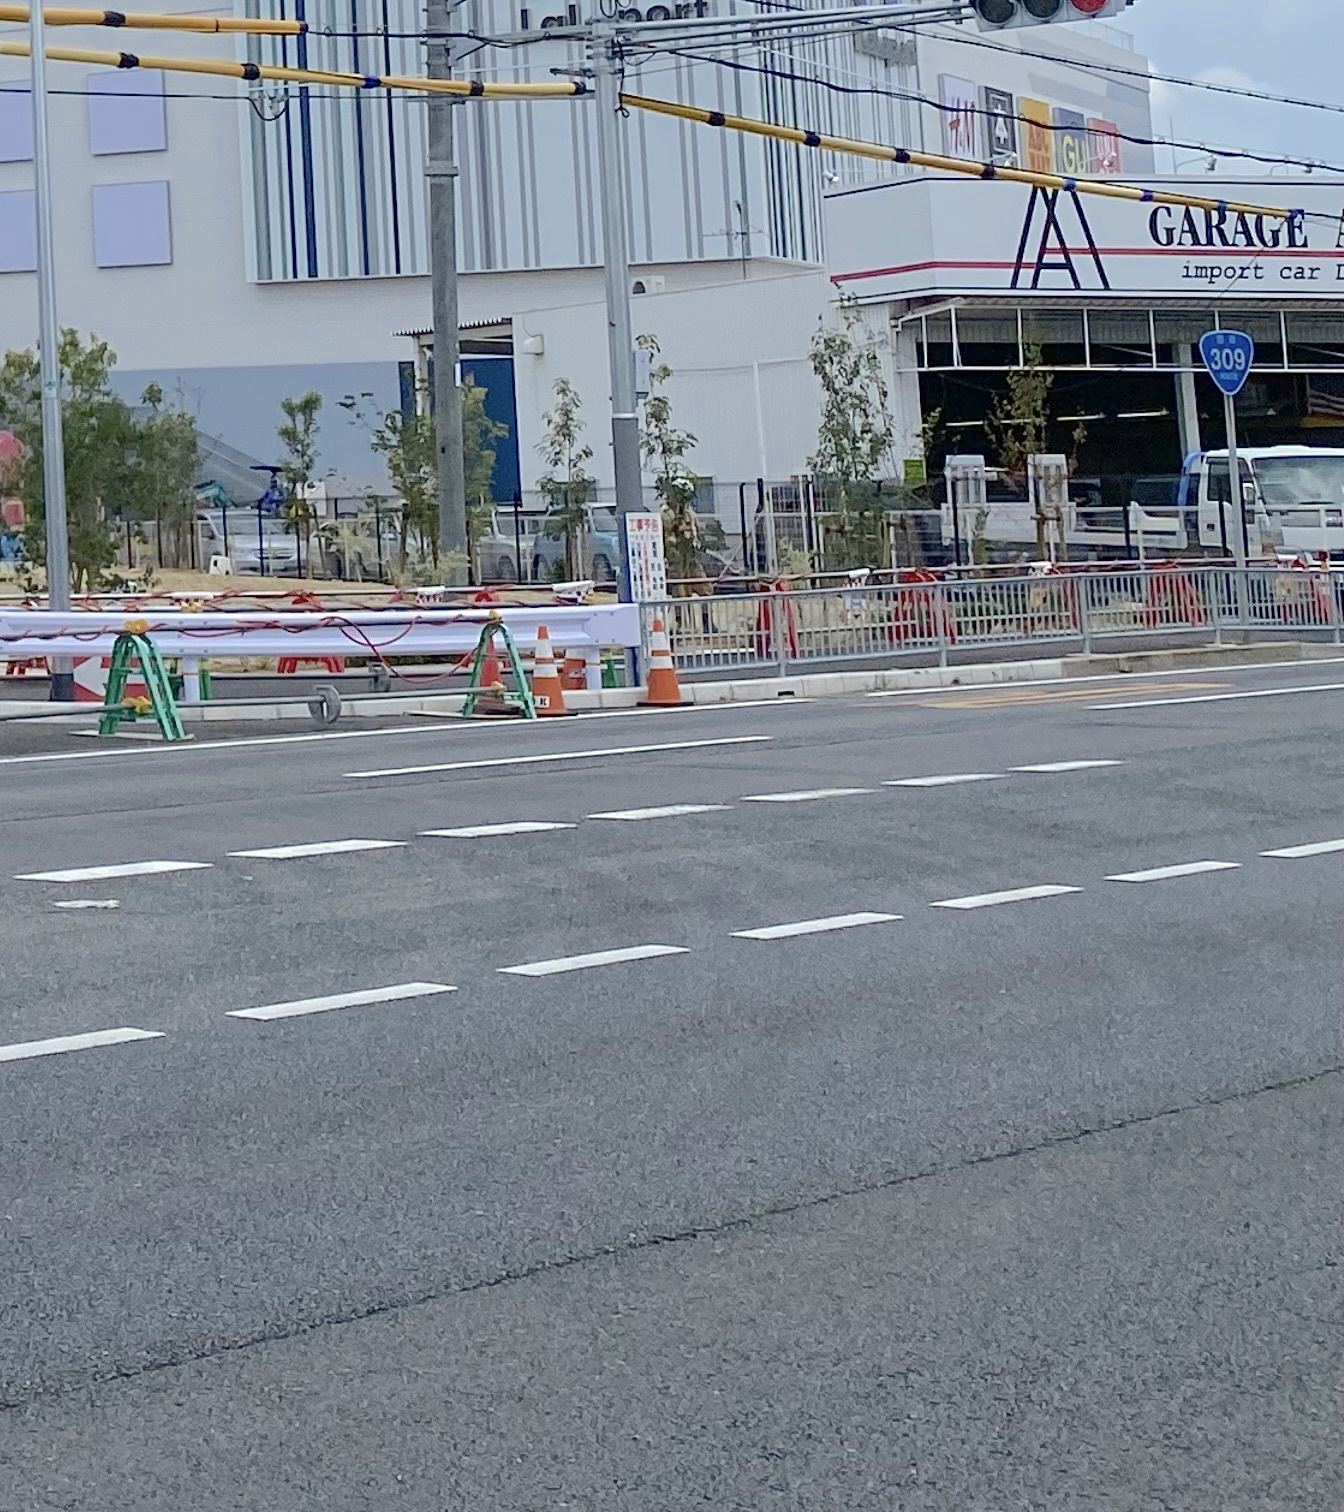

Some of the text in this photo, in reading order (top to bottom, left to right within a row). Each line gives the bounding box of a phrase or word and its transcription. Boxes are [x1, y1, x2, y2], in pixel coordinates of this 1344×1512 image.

[1149, 205, 1309, 249] GARAGE
[1182, 260, 1265, 285] import
[1279, 265, 1322, 280] car
[1210, 348, 1246, 371] 309
